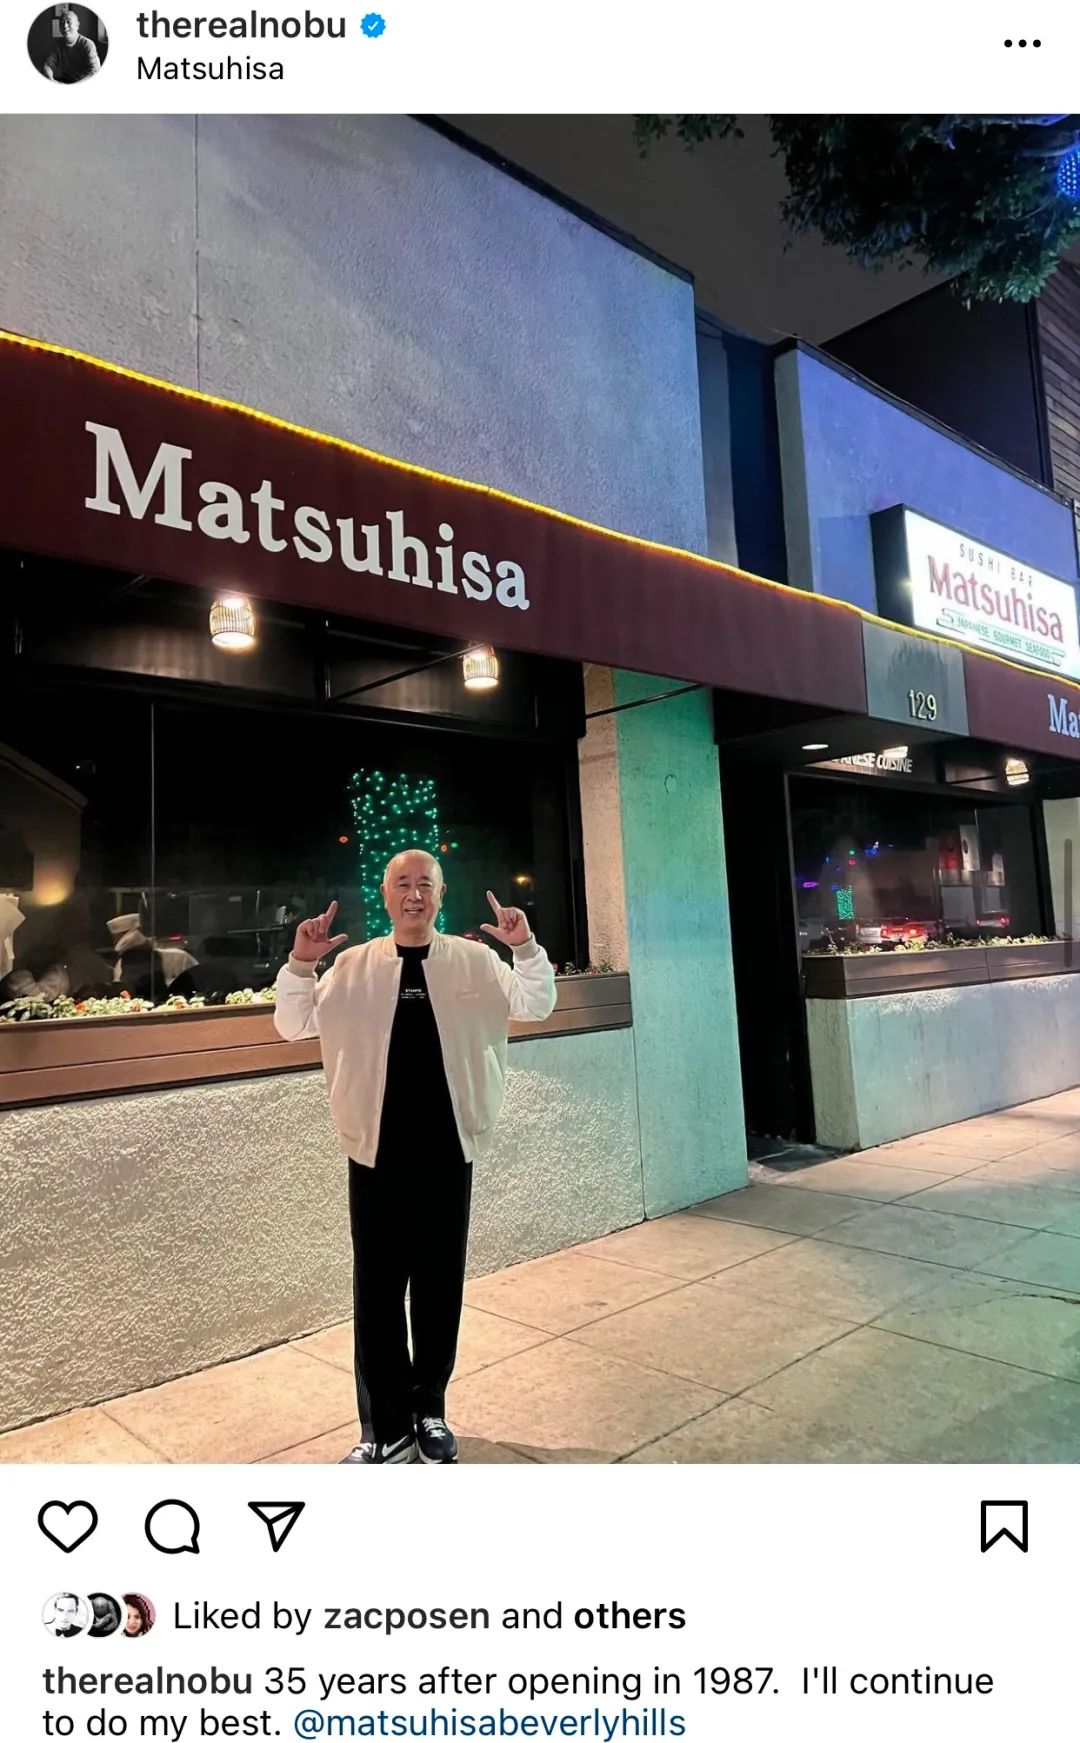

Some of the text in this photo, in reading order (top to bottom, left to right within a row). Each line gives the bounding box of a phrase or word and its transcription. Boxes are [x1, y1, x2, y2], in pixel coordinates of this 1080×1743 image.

[85, 420, 531, 610] Matsuhisa
[959, 543, 1033, 587] SUSHI BAR
[927, 554, 1065, 643] Matsuhisa
[909, 689, 937, 721] 129
[1047, 693, 1080, 739] Ma
